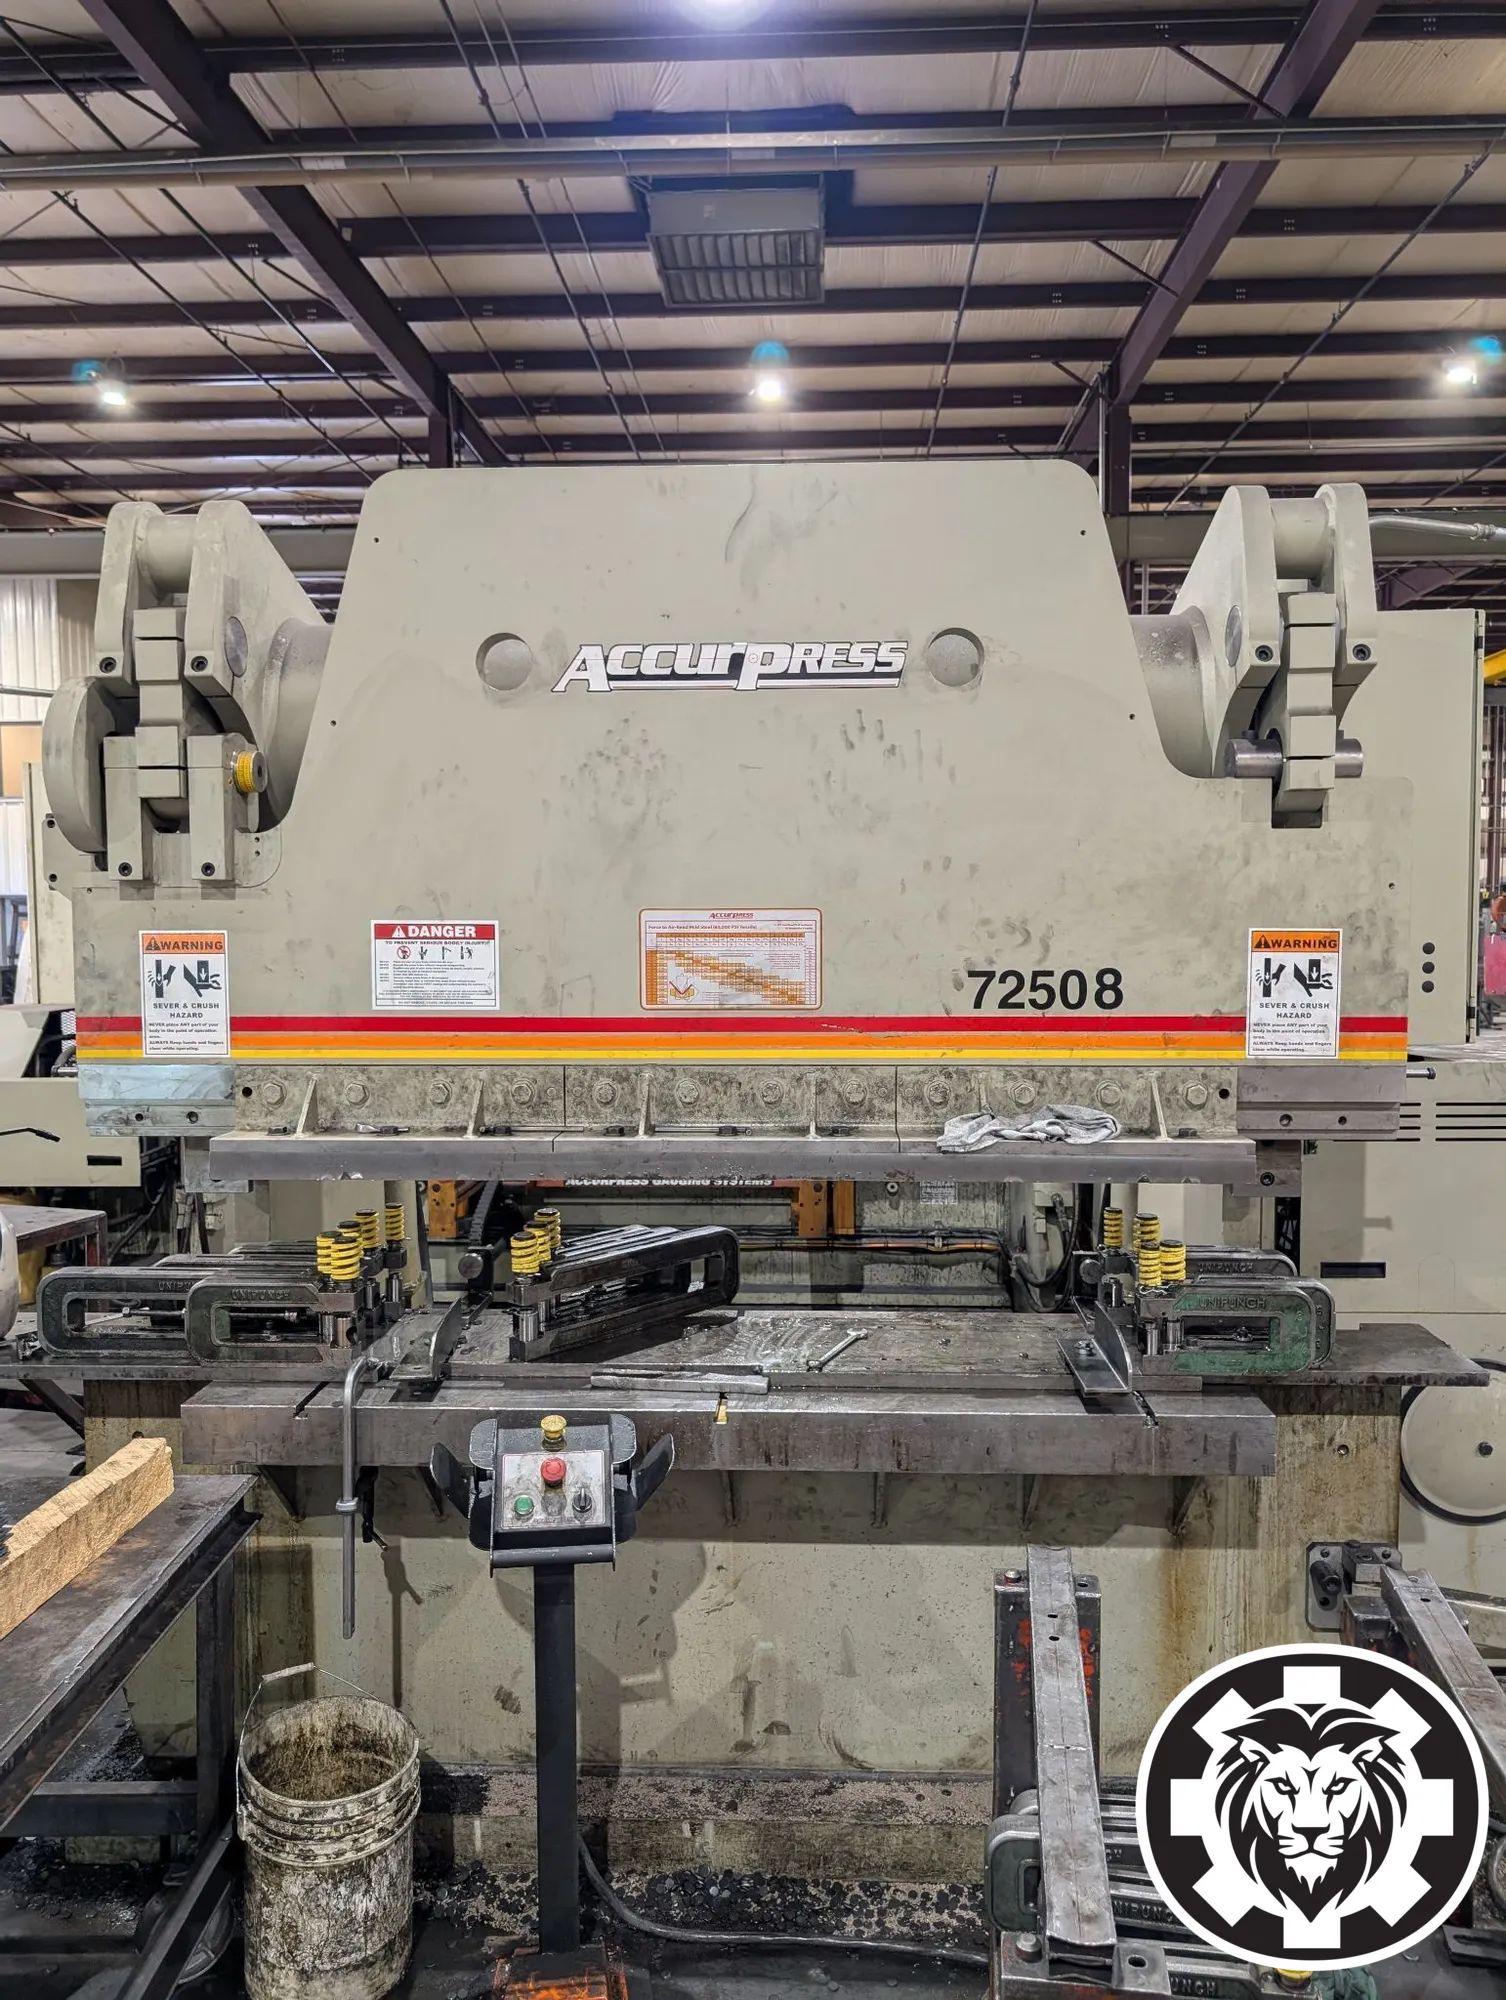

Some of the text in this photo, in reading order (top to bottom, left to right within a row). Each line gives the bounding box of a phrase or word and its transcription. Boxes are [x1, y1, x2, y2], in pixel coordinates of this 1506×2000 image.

[408, 925, 476, 937] DANGER
[161, 941, 224, 950] WARNING
[1271, 939, 1337, 949] WARNING
[967, 967, 1124, 1010] 72508
[1200, 1296, 1266, 1309] UNIPUNCH
